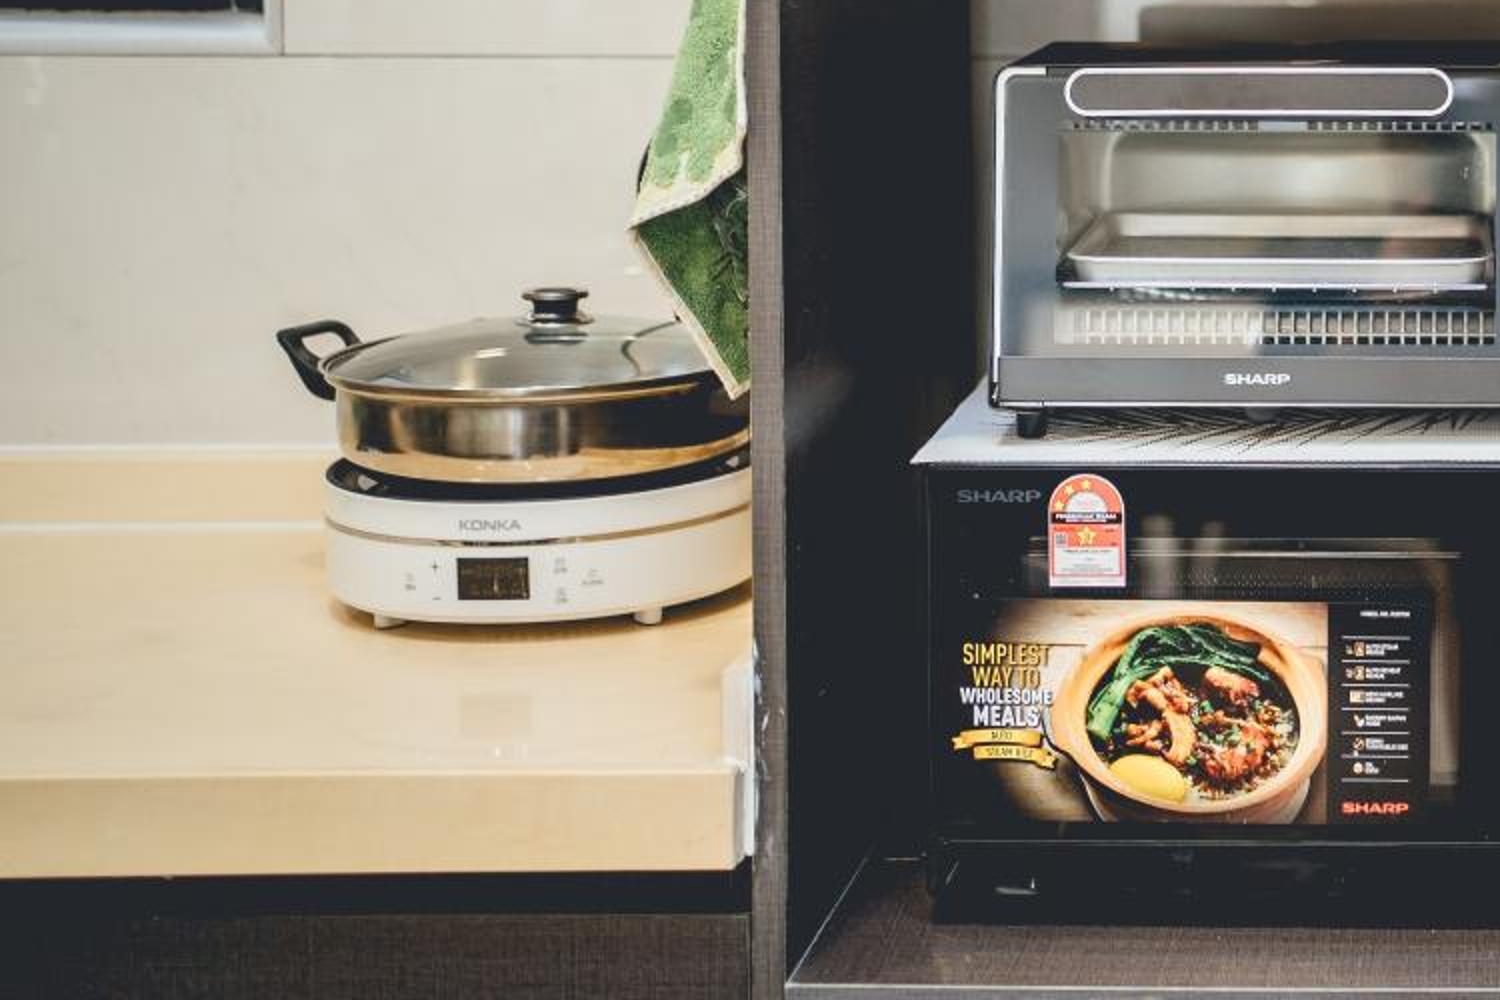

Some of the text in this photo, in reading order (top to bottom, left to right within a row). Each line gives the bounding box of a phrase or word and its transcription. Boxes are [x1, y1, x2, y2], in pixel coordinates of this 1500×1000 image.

[1225, 373, 1291, 385] SHARP
[957, 489, 1042, 503] SHARP
[459, 519, 521, 531] KONKA
[962, 643, 1049, 666] SIMPLEST
[972, 665, 1041, 688] WAY TO
[959, 687, 1053, 705] WHOLESOME
[973, 705, 1039, 727] MEALS
[1342, 801, 1409, 814] SHARP
